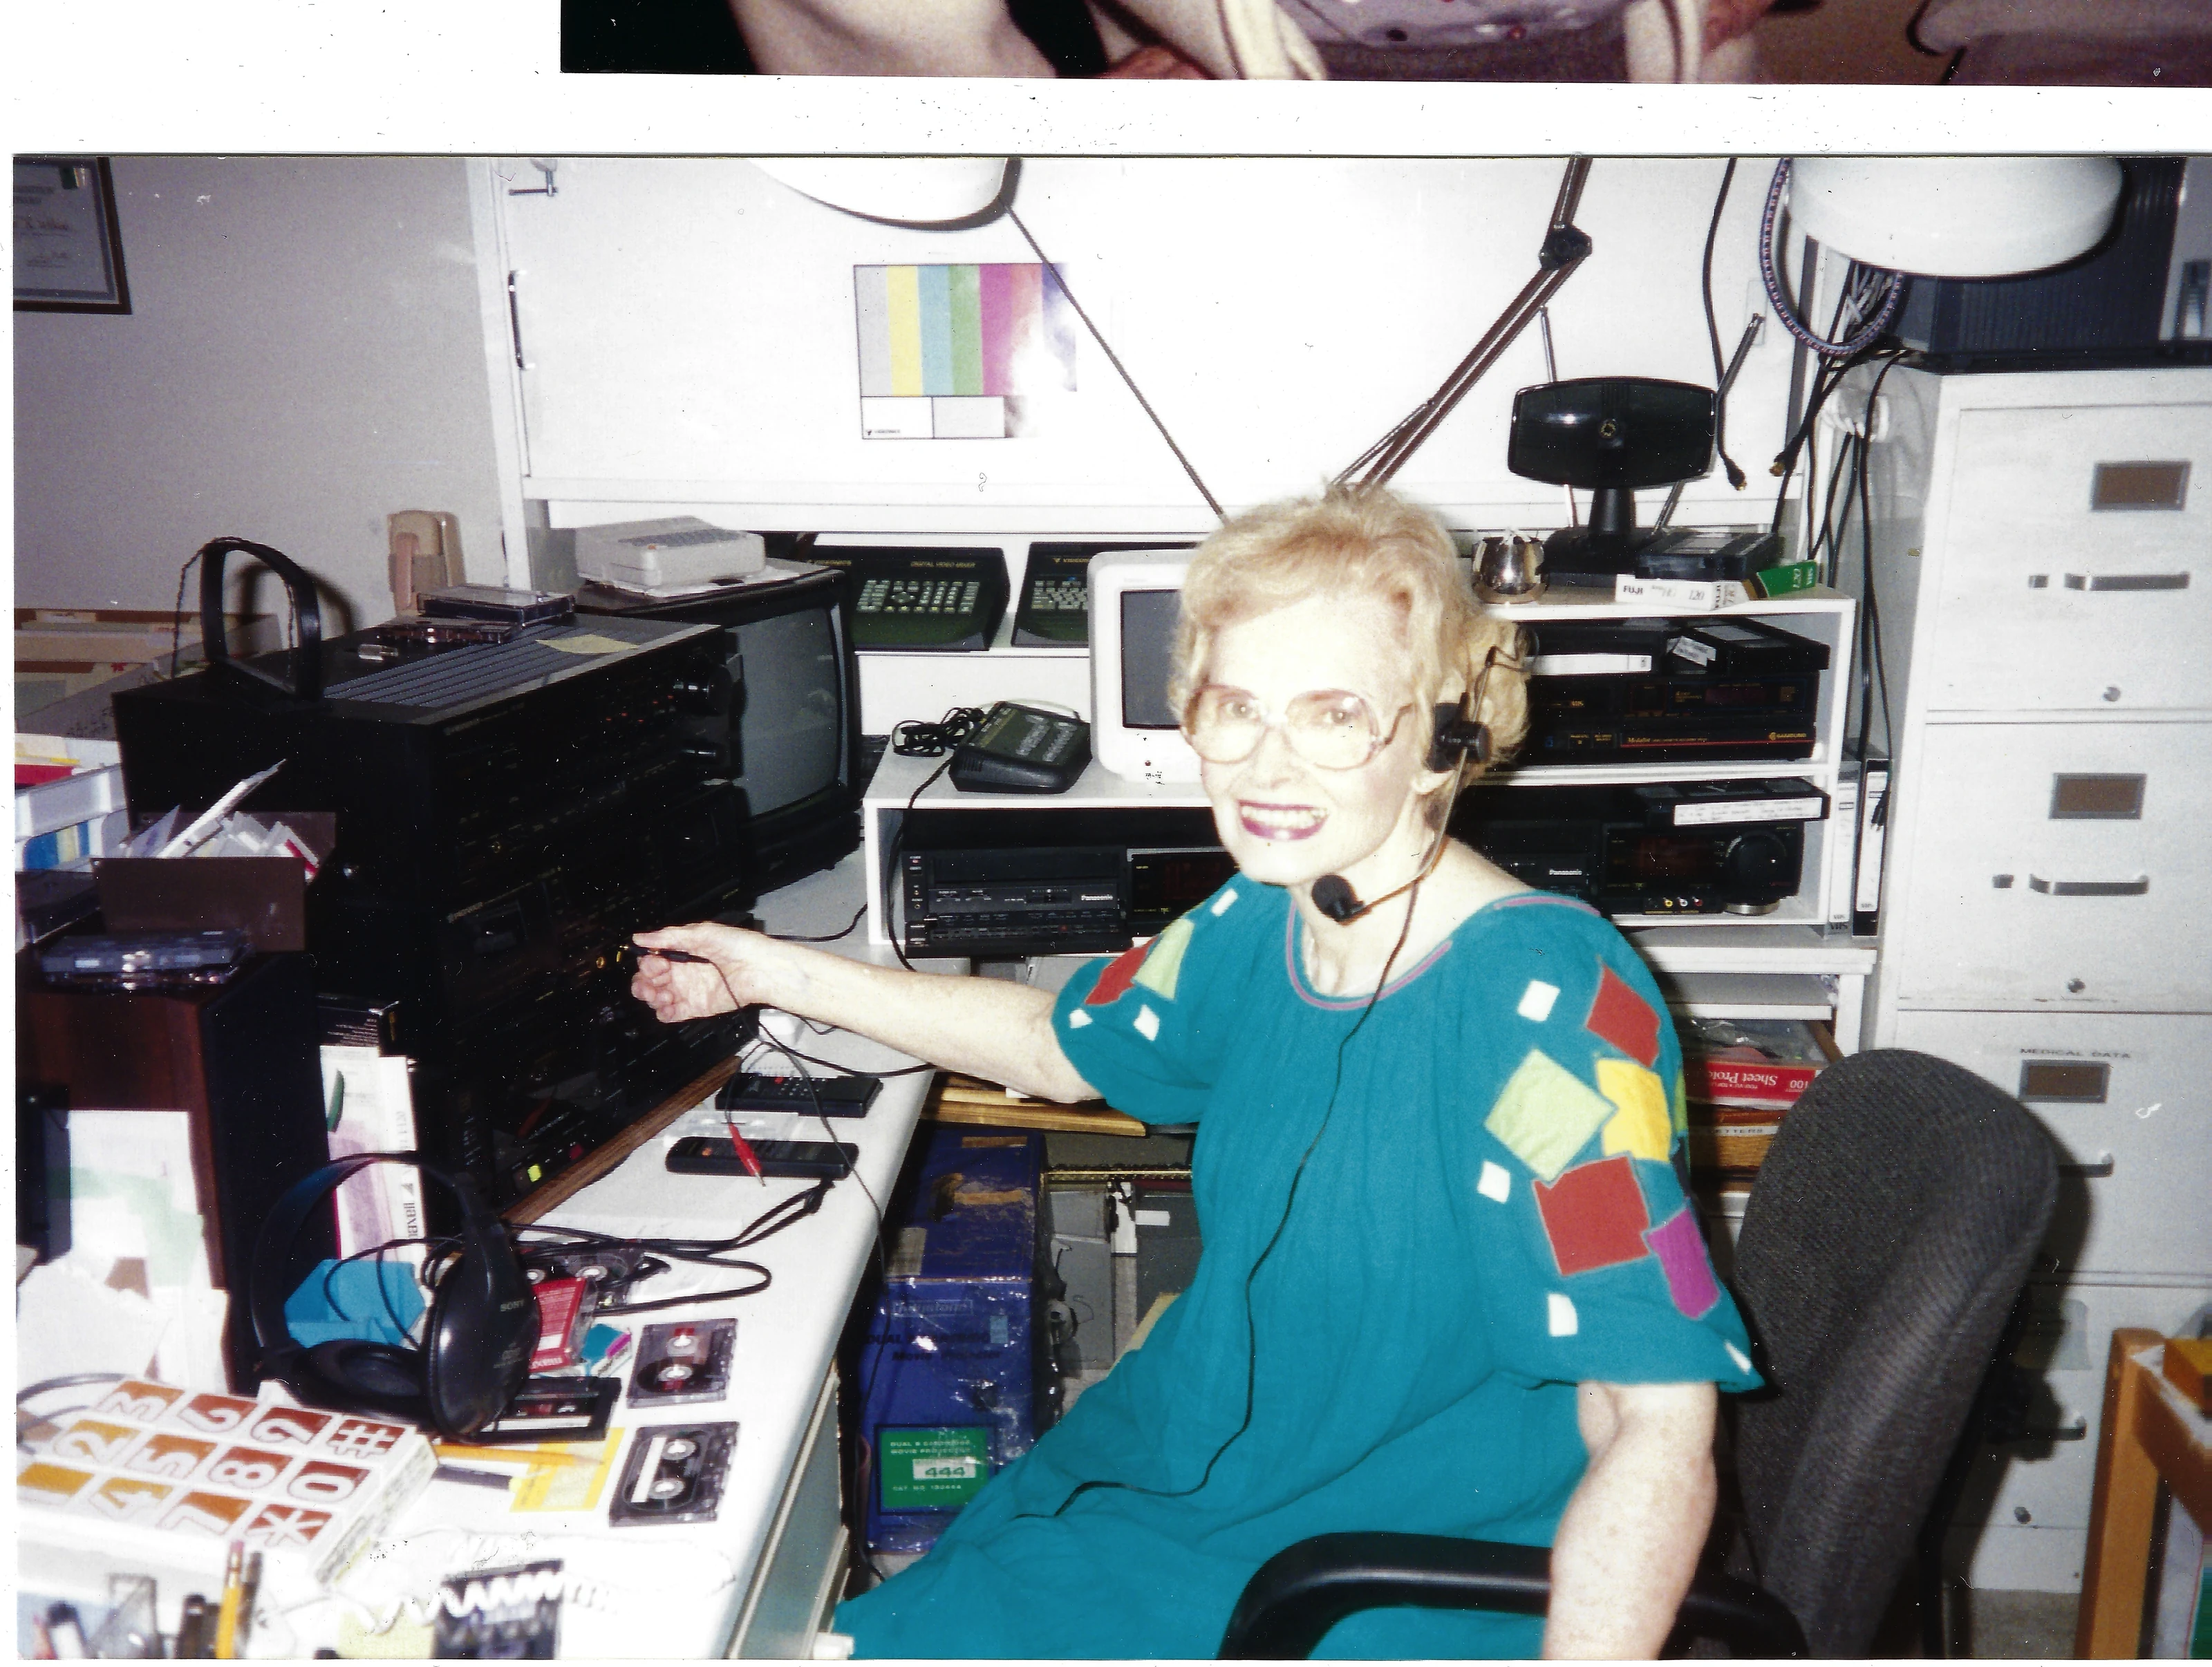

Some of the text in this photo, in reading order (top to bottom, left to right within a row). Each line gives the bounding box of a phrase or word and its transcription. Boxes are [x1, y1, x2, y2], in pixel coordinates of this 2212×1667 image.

[1623, 585, 1644, 596] FUJI
[1688, 589, 1705, 601] 120
[2021, 1048, 2083, 1057] MEDICAL
[1741, 1072, 1779, 1086] Sheet
[1789, 1079, 1809, 1089] 100
[53, 1430, 123, 1464] 2
[95, 1391, 166, 1422] 3
[88, 1406, 241, 1519] 4 5 6
[156, 1417, 315, 1536] 7 8 9
[925, 1467, 965, 1477] 444
[286, 1472, 354, 1503] 0
